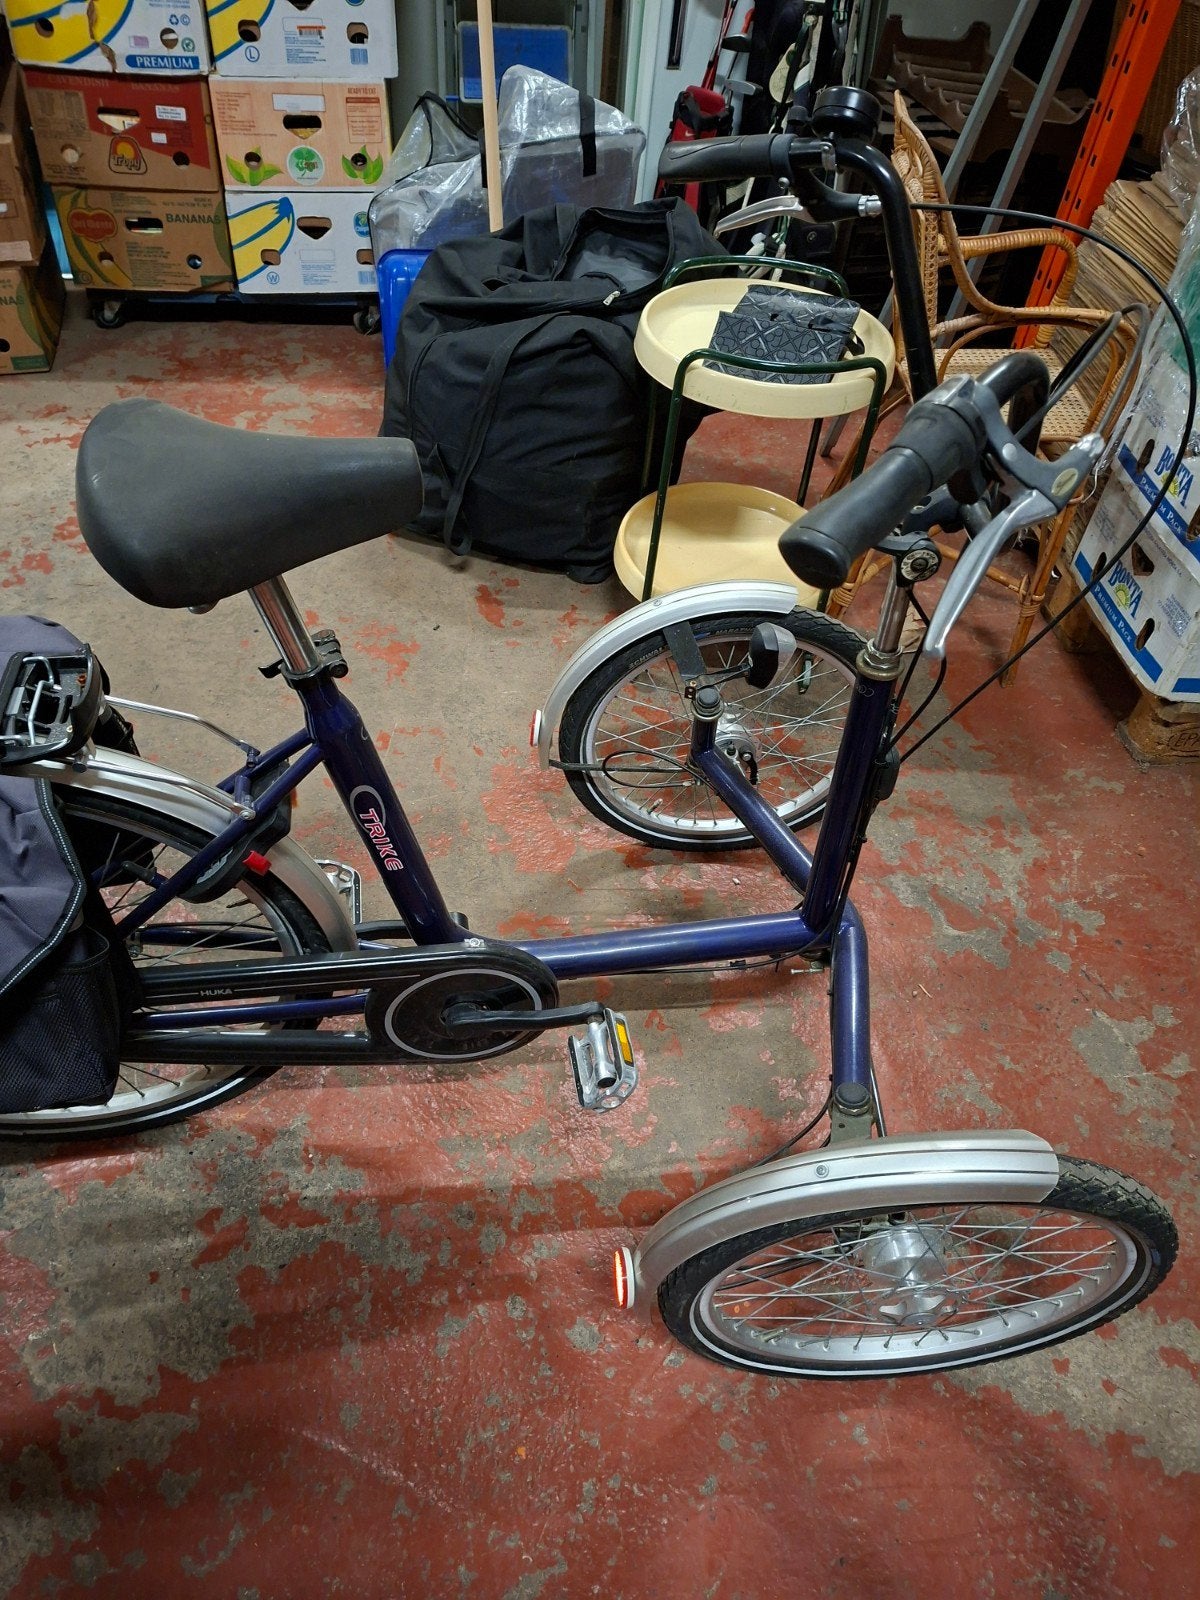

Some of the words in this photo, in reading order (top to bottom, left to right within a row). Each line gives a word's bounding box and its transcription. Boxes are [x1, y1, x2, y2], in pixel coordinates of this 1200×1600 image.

[136, 56, 194, 69] PREMIUM
[166, 213, 222, 225] BANANAS
[1154, 445, 1194, 507] BOITA
[1140, 477, 1167, 514] PREMM
[1167, 511, 1183, 534] PACK
[1094, 585, 1118, 622] PREMIUM
[1118, 620, 1132, 642] PACK
[1108, 561, 1143, 618] BONITA
[360, 808, 404, 871] TRIKE
[200, 988, 233, 997] HUKA
